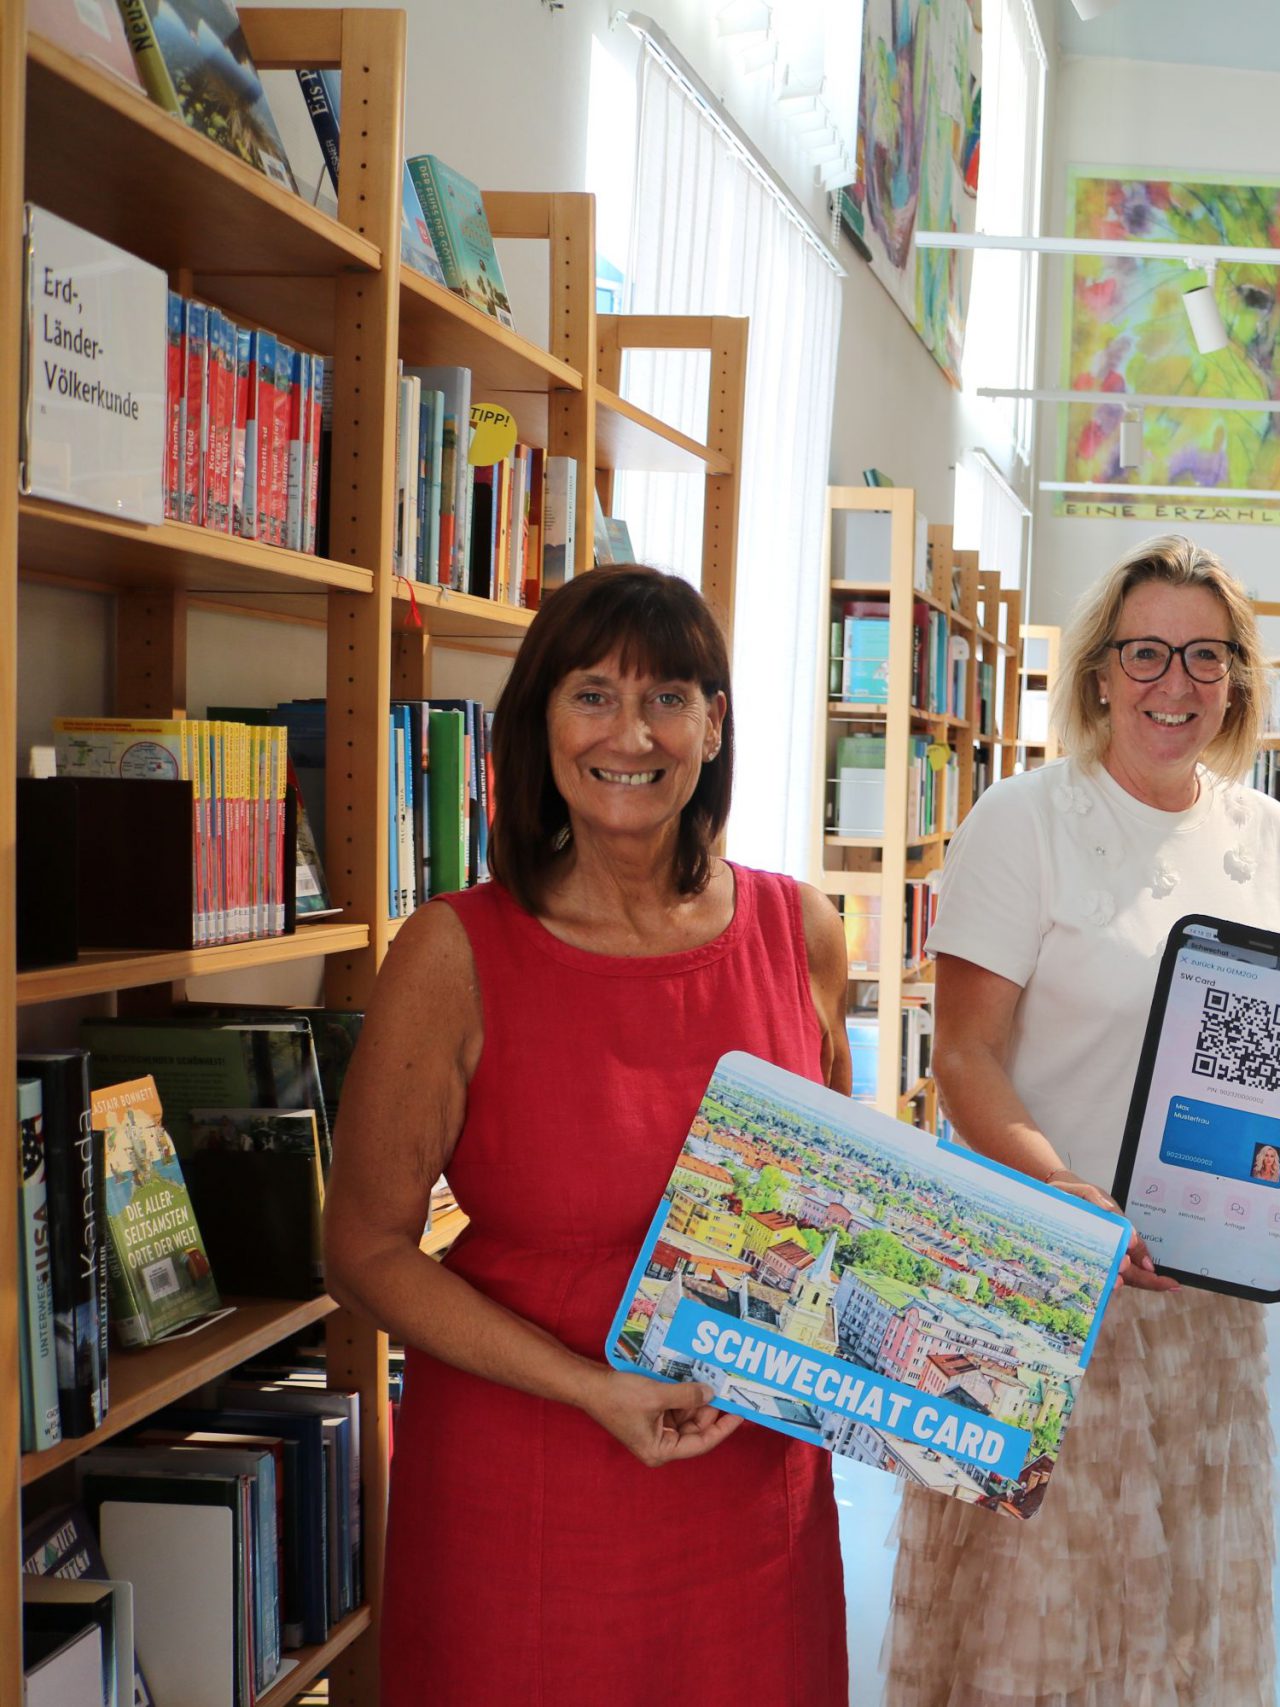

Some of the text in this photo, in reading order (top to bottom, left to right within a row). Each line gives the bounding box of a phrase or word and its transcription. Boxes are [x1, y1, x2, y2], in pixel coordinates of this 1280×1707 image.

[43, 267, 82, 314] Erd-,
[43, 314, 104, 359] Länder-
[44, 360, 139, 420] Völkerkunde
[470, 407, 511, 428] TIPP!
[1065, 503, 1137, 518] EINE
[1190, 942, 1230, 958] Schwechat
[1180, 972, 1217, 987] SW Card
[1191, 957, 1215, 970] zurück
[1226, 967, 1259, 981] GEM2GO
[120, 1086, 155, 1107] BONNETT
[1175, 1103, 1190, 1112] Max
[1173, 1111, 1211, 1126] Musterfrau
[74, 1109, 97, 1279] Kanada
[125, 1189, 175, 1222] DIE ALLER-
[124, 1206, 189, 1247] SELTSAMSTEN
[127, 1225, 199, 1269] ORTE DER WELT
[35, 1275, 48, 1358] UNTERWEGS
[690, 1319, 1006, 1466] SCHWECHAT CARD
